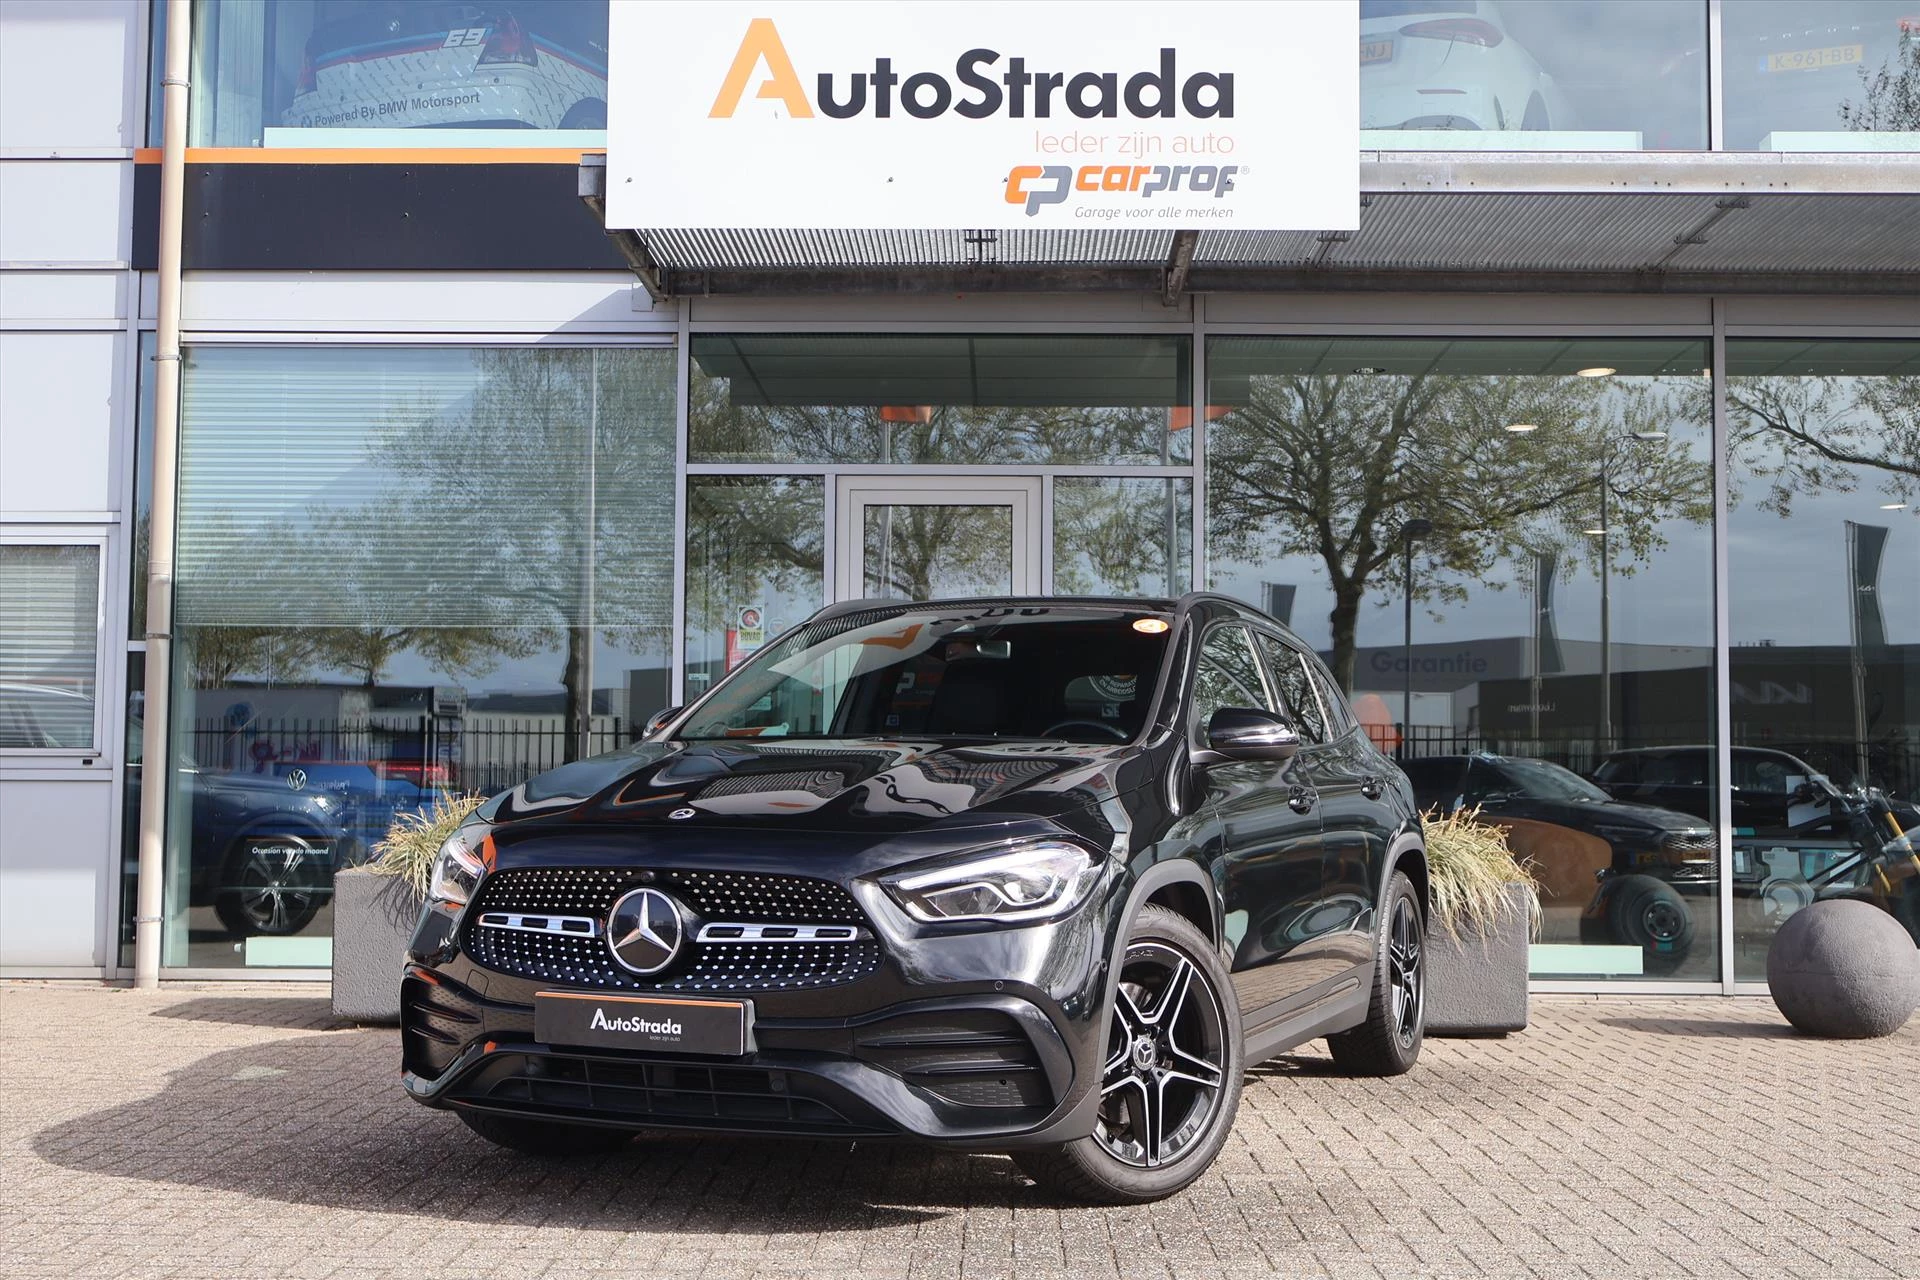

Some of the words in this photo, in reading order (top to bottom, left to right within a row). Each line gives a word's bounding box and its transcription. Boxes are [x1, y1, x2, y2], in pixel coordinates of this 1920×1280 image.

[442, 27, 487, 48] 69
[707, 17, 1235, 120] AutoStrada
[1775, 47, 1855, 69] K-961-BB
[314, 107, 359, 127] Powered
[360, 105, 377, 120] By
[378, 99, 409, 116] BMW
[411, 91, 482, 112] Motorsport
[1034, 130, 1109, 154] Ieder
[1117, 131, 1163, 160] zijn
[1171, 131, 1235, 154] auto
[1074, 164, 1240, 199] carprof
[1074, 206, 1122, 221] Garage
[1125, 208, 1154, 219] voor
[1157, 206, 1182, 219] alle
[1185, 206, 1234, 219] merken
[1370, 650, 1488, 673] Garantie
[252, 846, 281, 855] Occasion
[304, 846, 329, 855] maand
[590, 1007, 682, 1035] AutoStrada
